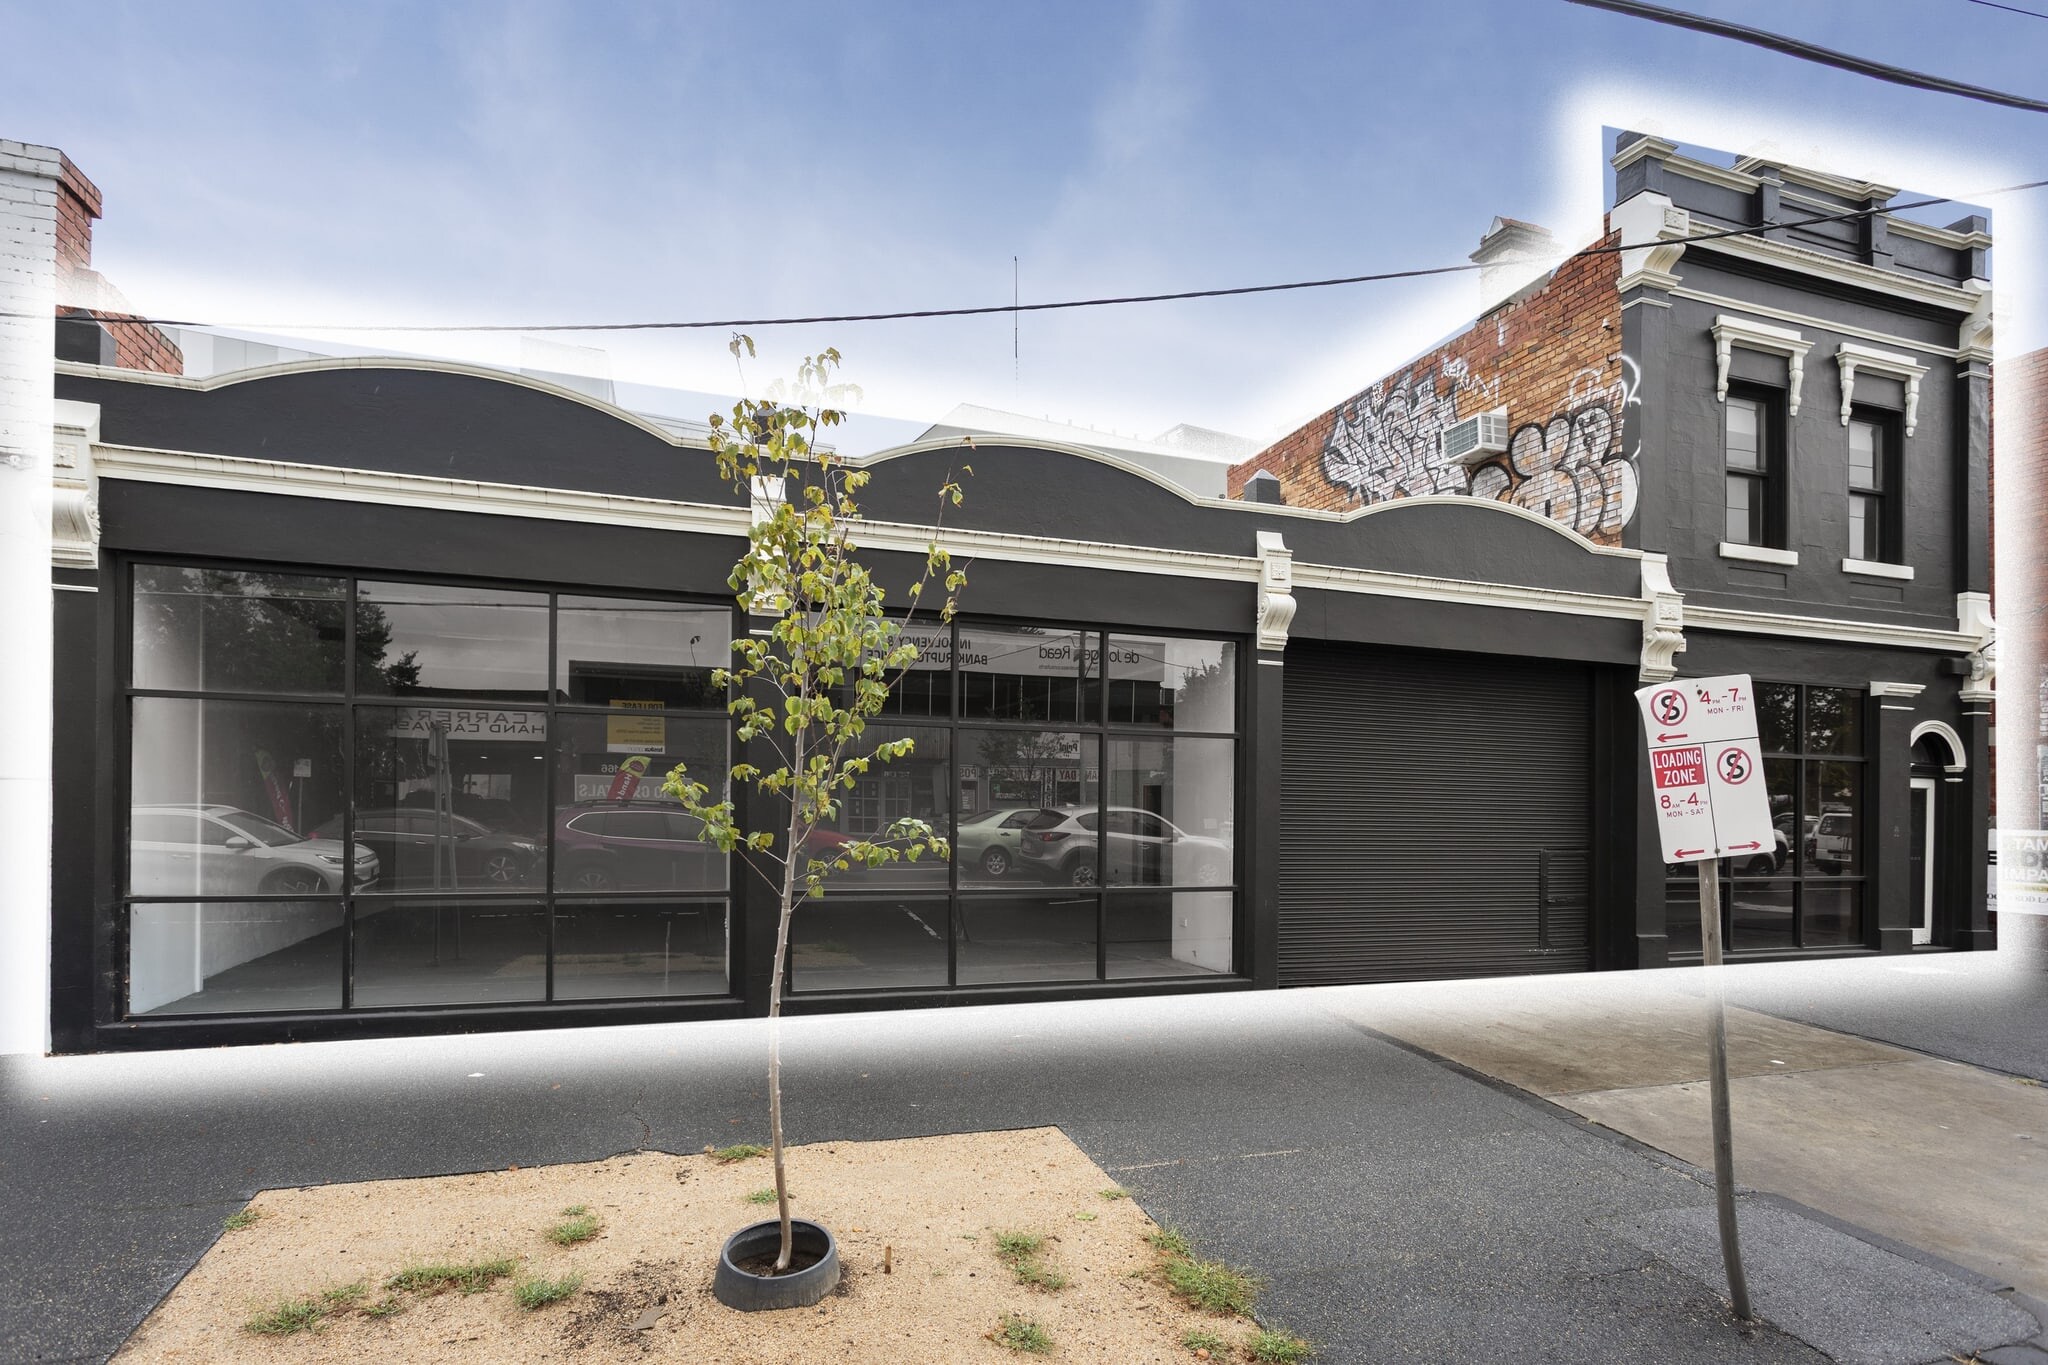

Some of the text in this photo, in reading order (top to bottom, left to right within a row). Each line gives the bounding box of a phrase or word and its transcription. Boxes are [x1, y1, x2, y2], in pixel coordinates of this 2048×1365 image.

[1707, 706, 1724, 715] MON
[1731, 704, 1744, 713] FRI
[1654, 749, 1702, 769] LOADING
[1663, 768, 1698, 786] ZONE
[1666, 810, 1684, 818] MON
[1690, 807, 1705, 816] SAT
